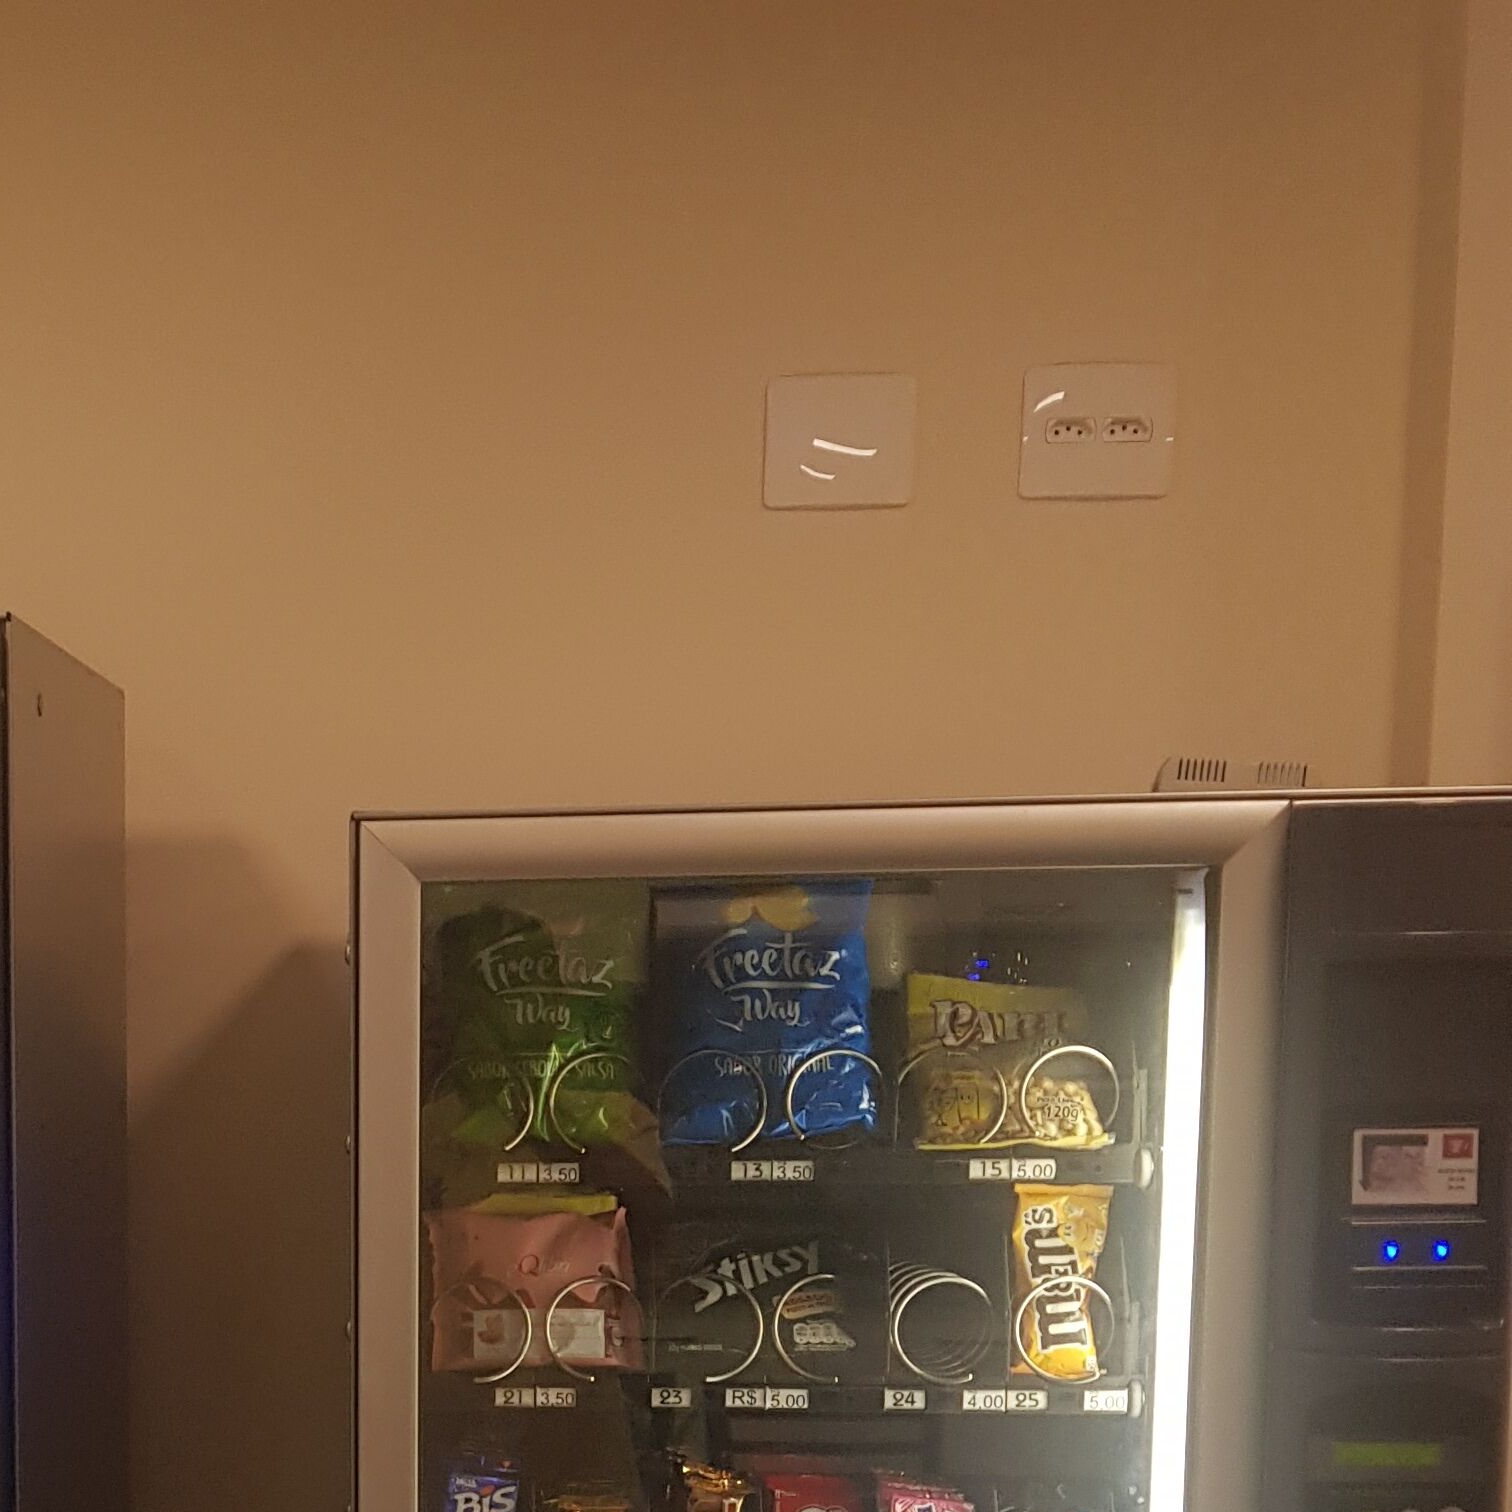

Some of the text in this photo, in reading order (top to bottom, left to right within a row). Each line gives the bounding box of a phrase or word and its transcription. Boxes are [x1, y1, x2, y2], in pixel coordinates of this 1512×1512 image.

[730, 988, 809, 1027] Way
[1045, 1105, 1080, 1122] 120g
[740, 1162, 764, 1179] 13
[979, 1160, 1003, 1178] 15
[502, 1388, 524, 1404] 21
[659, 1389, 683, 1405] 23
[731, 1389, 758, 1407] R$
[892, 1391, 917, 1408] 24
[1014, 1391, 1040, 1408] 25
